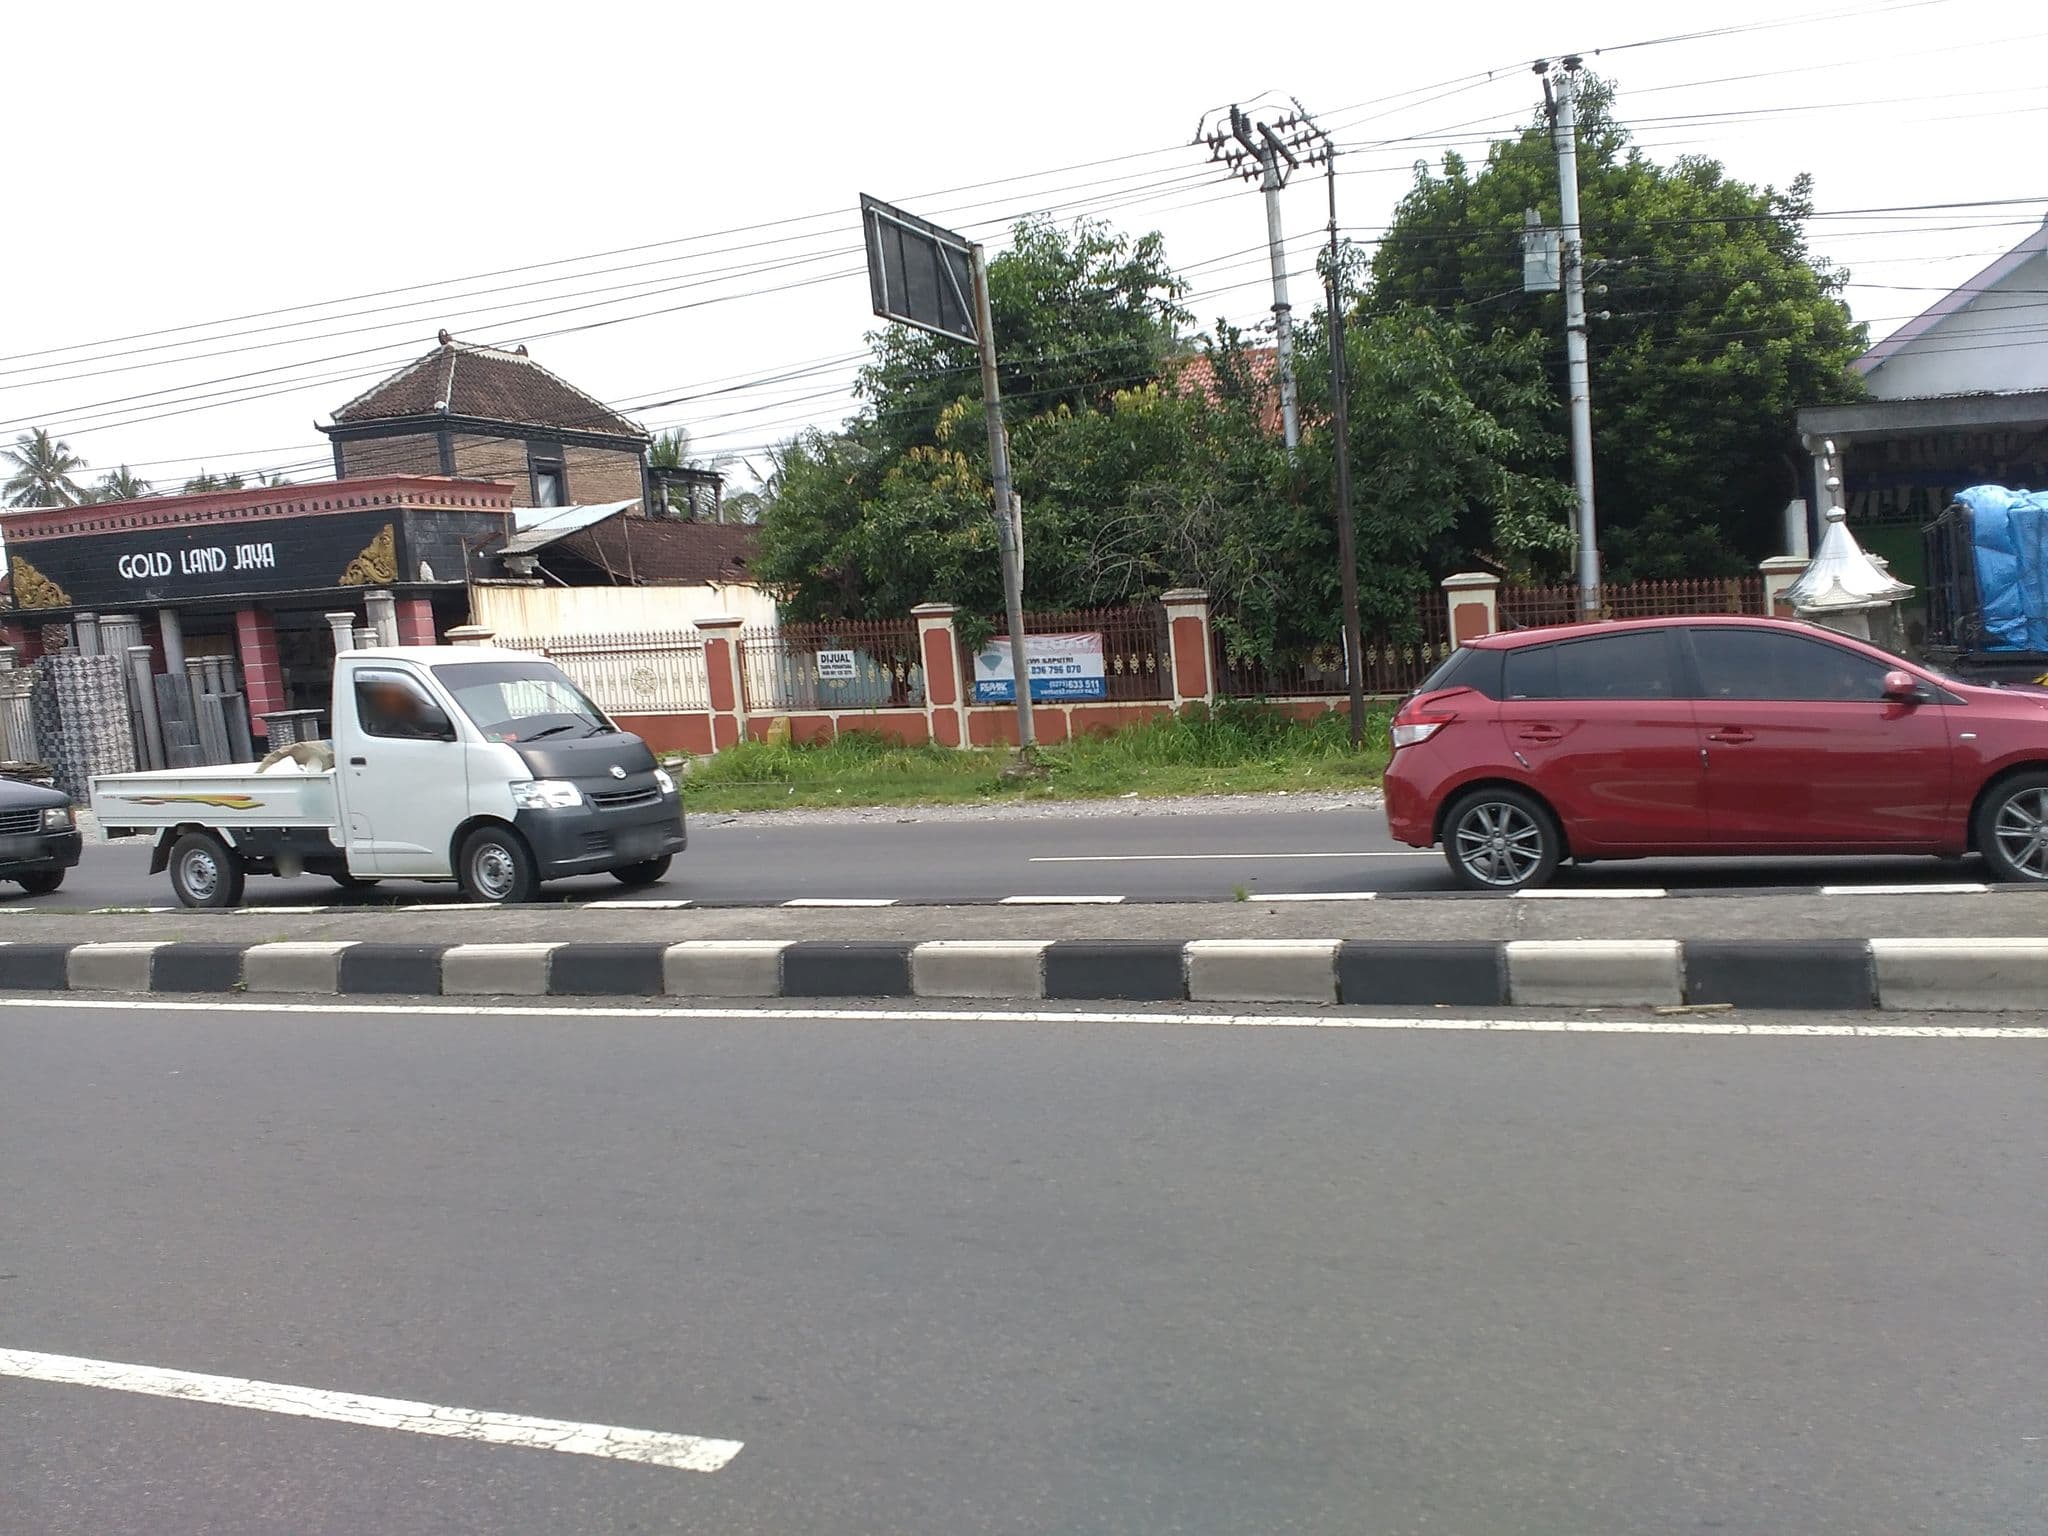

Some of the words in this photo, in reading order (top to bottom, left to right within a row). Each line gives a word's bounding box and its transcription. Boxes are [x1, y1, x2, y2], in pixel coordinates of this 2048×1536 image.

[118, 552, 173, 579] GOLD
[180, 547, 227, 575] LAND
[232, 542, 275, 570] JAYA
[820, 653, 851, 663] DIJUAL
